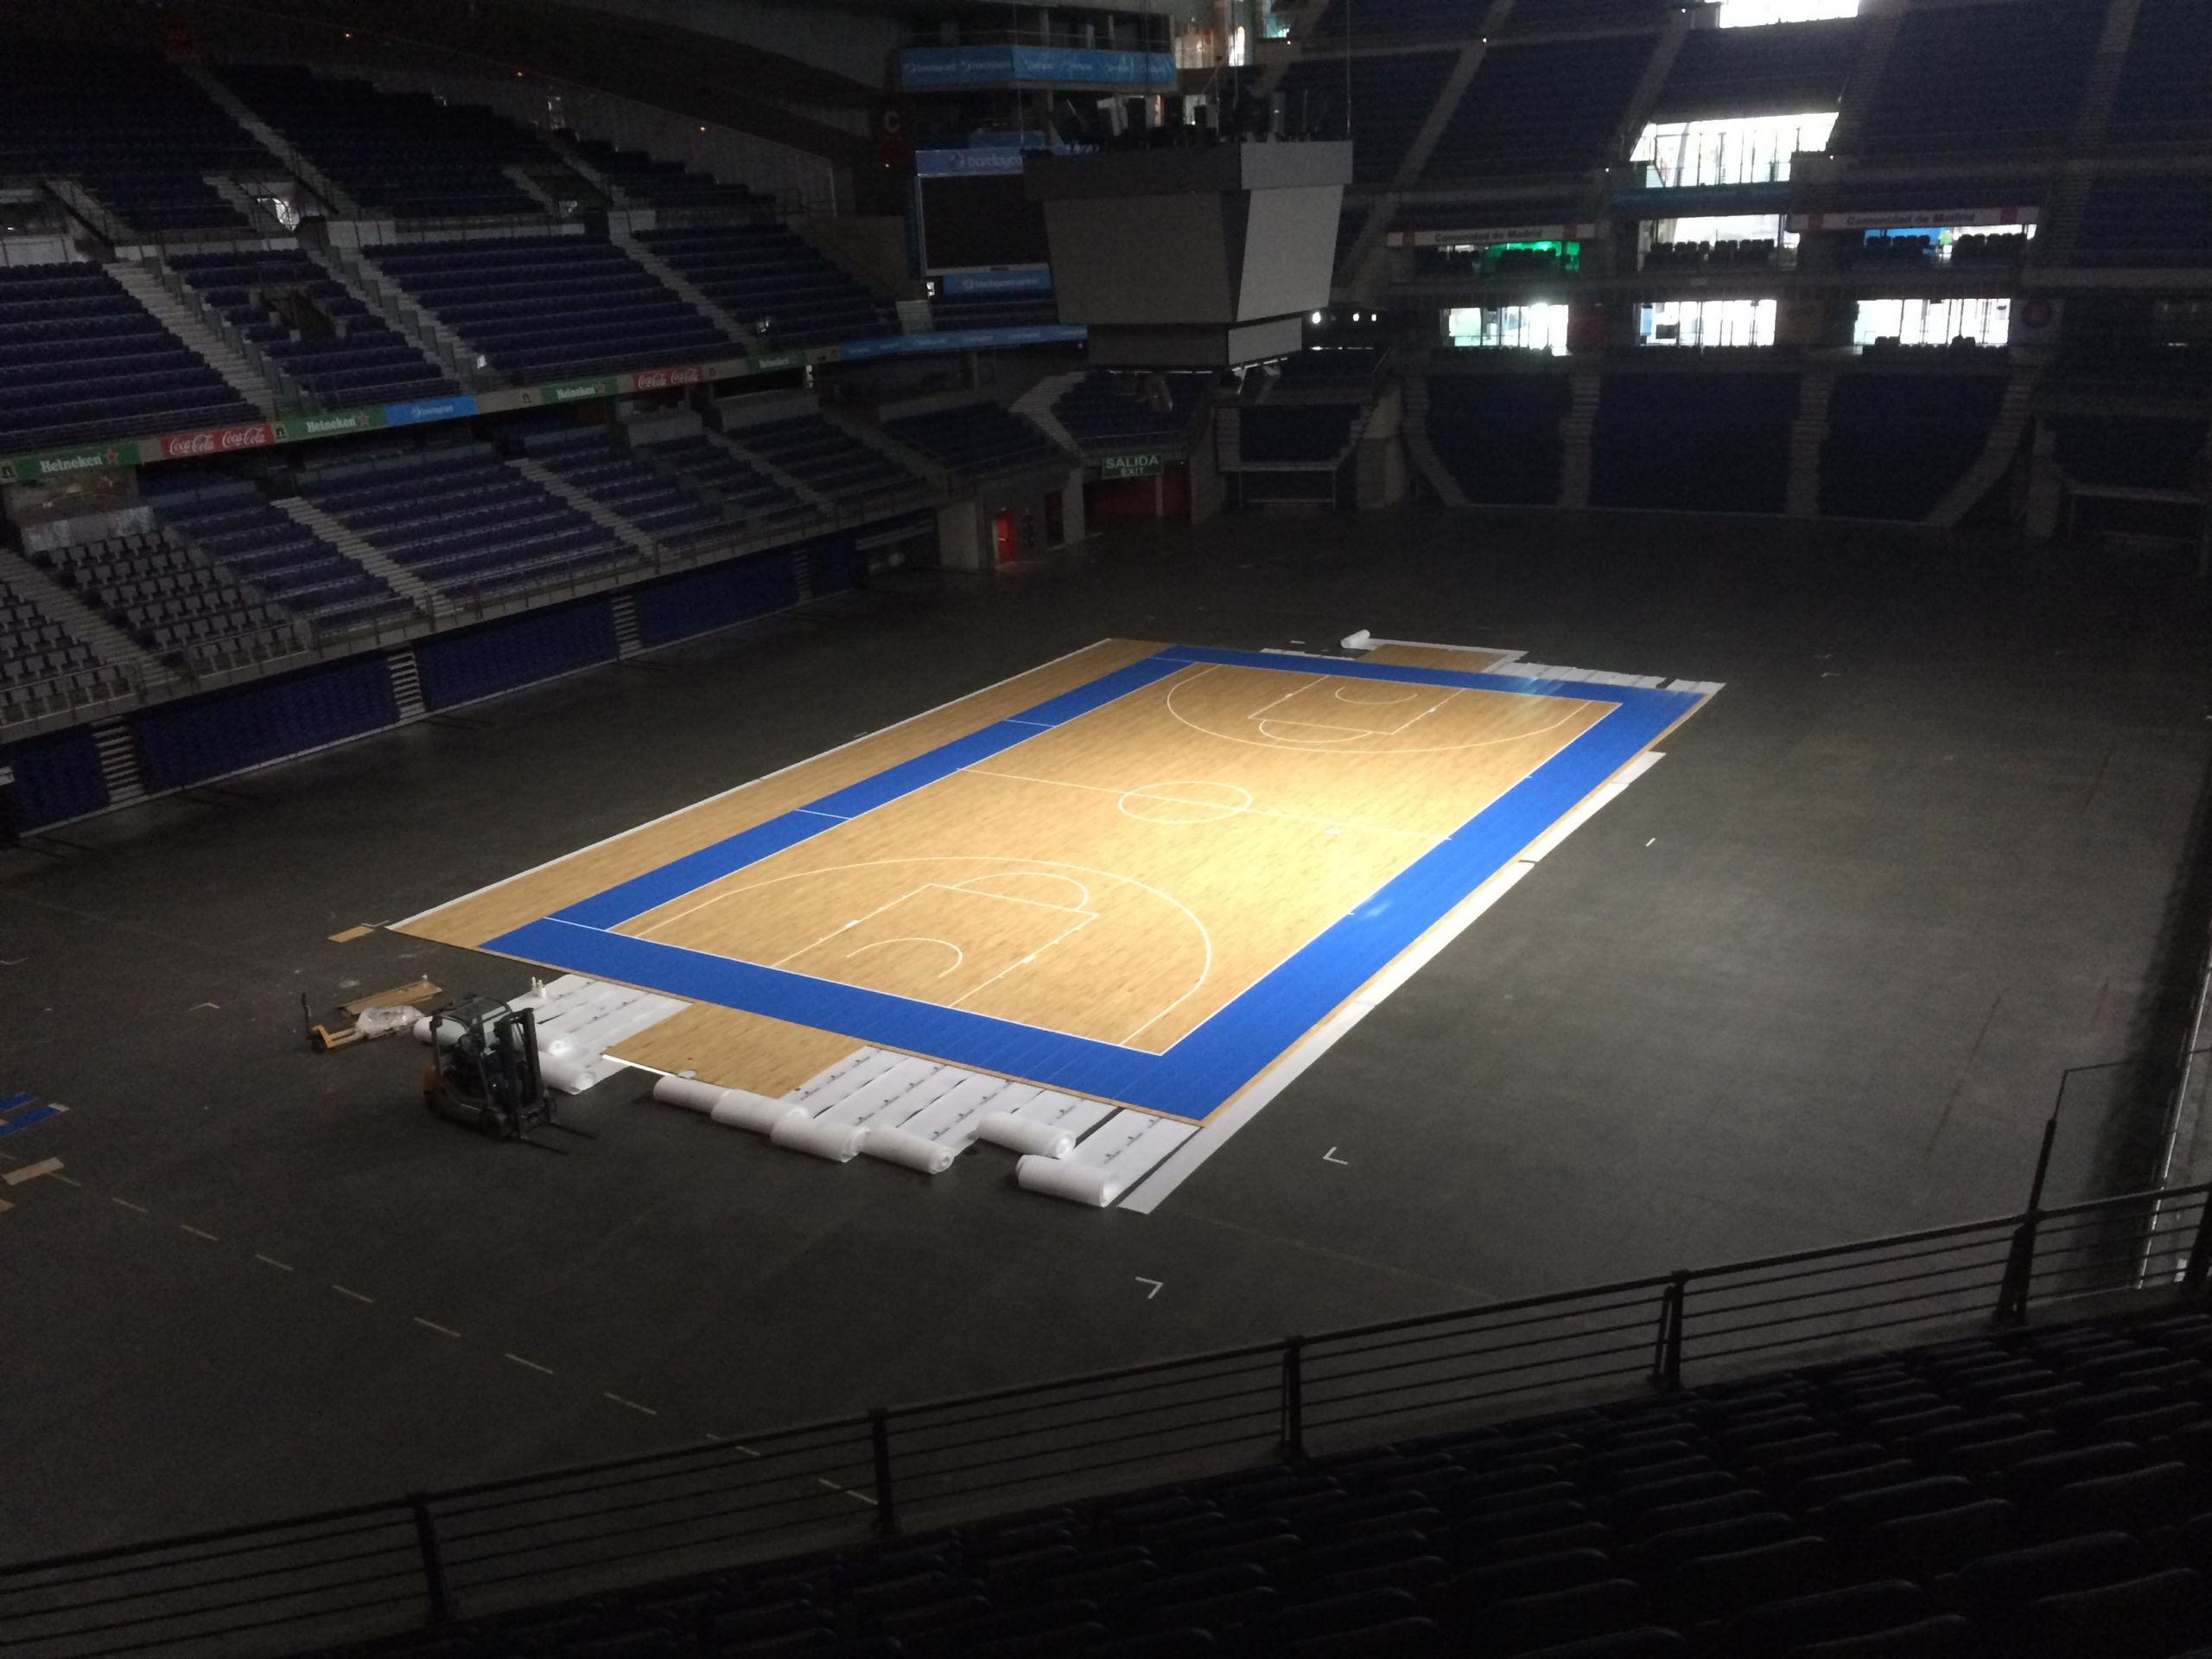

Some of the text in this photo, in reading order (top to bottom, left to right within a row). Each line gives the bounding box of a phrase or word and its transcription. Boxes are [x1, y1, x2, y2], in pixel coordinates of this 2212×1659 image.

[305, 416, 357, 432] Heineken
[40, 454, 103, 474] Heineken
[1105, 455, 1159, 469] SALIDA
[1121, 467, 1144, 476] EXIT
